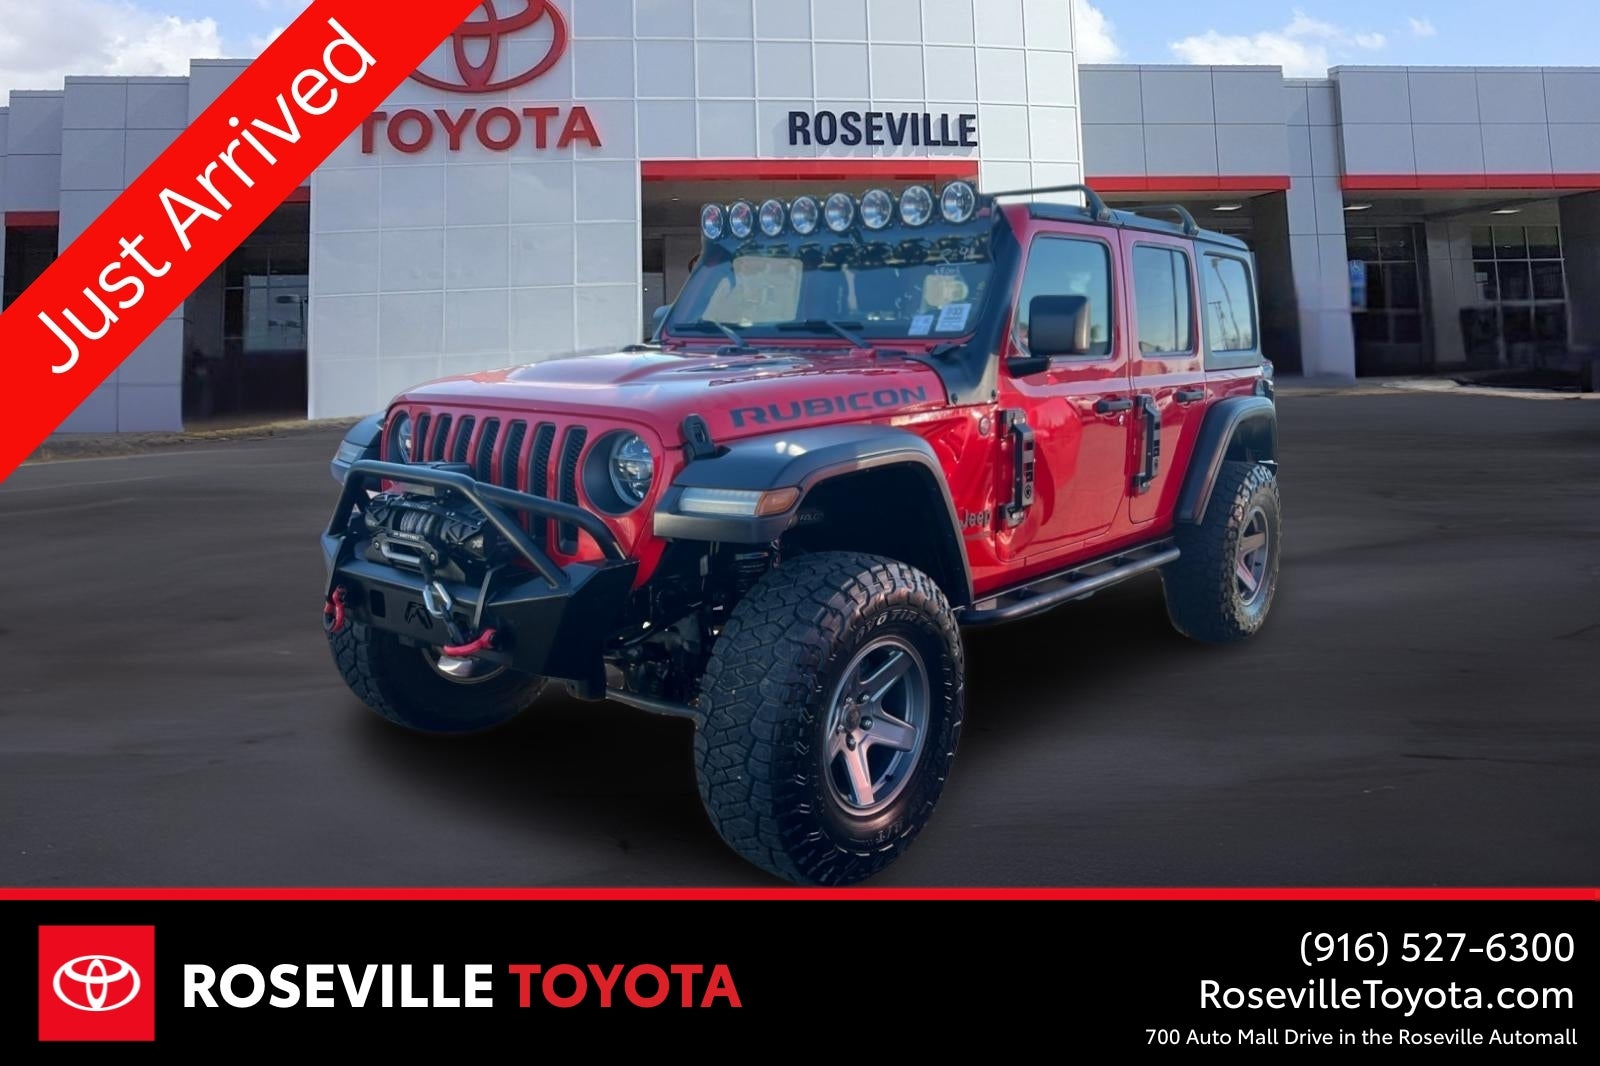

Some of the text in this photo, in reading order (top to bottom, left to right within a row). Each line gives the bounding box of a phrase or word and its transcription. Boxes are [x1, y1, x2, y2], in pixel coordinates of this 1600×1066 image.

[361, 106, 602, 154] TOYOTA
[788, 111, 978, 147] ROSEVILLE
[730, 386, 926, 427] RUBICON
[960, 509, 992, 529] Jeep
